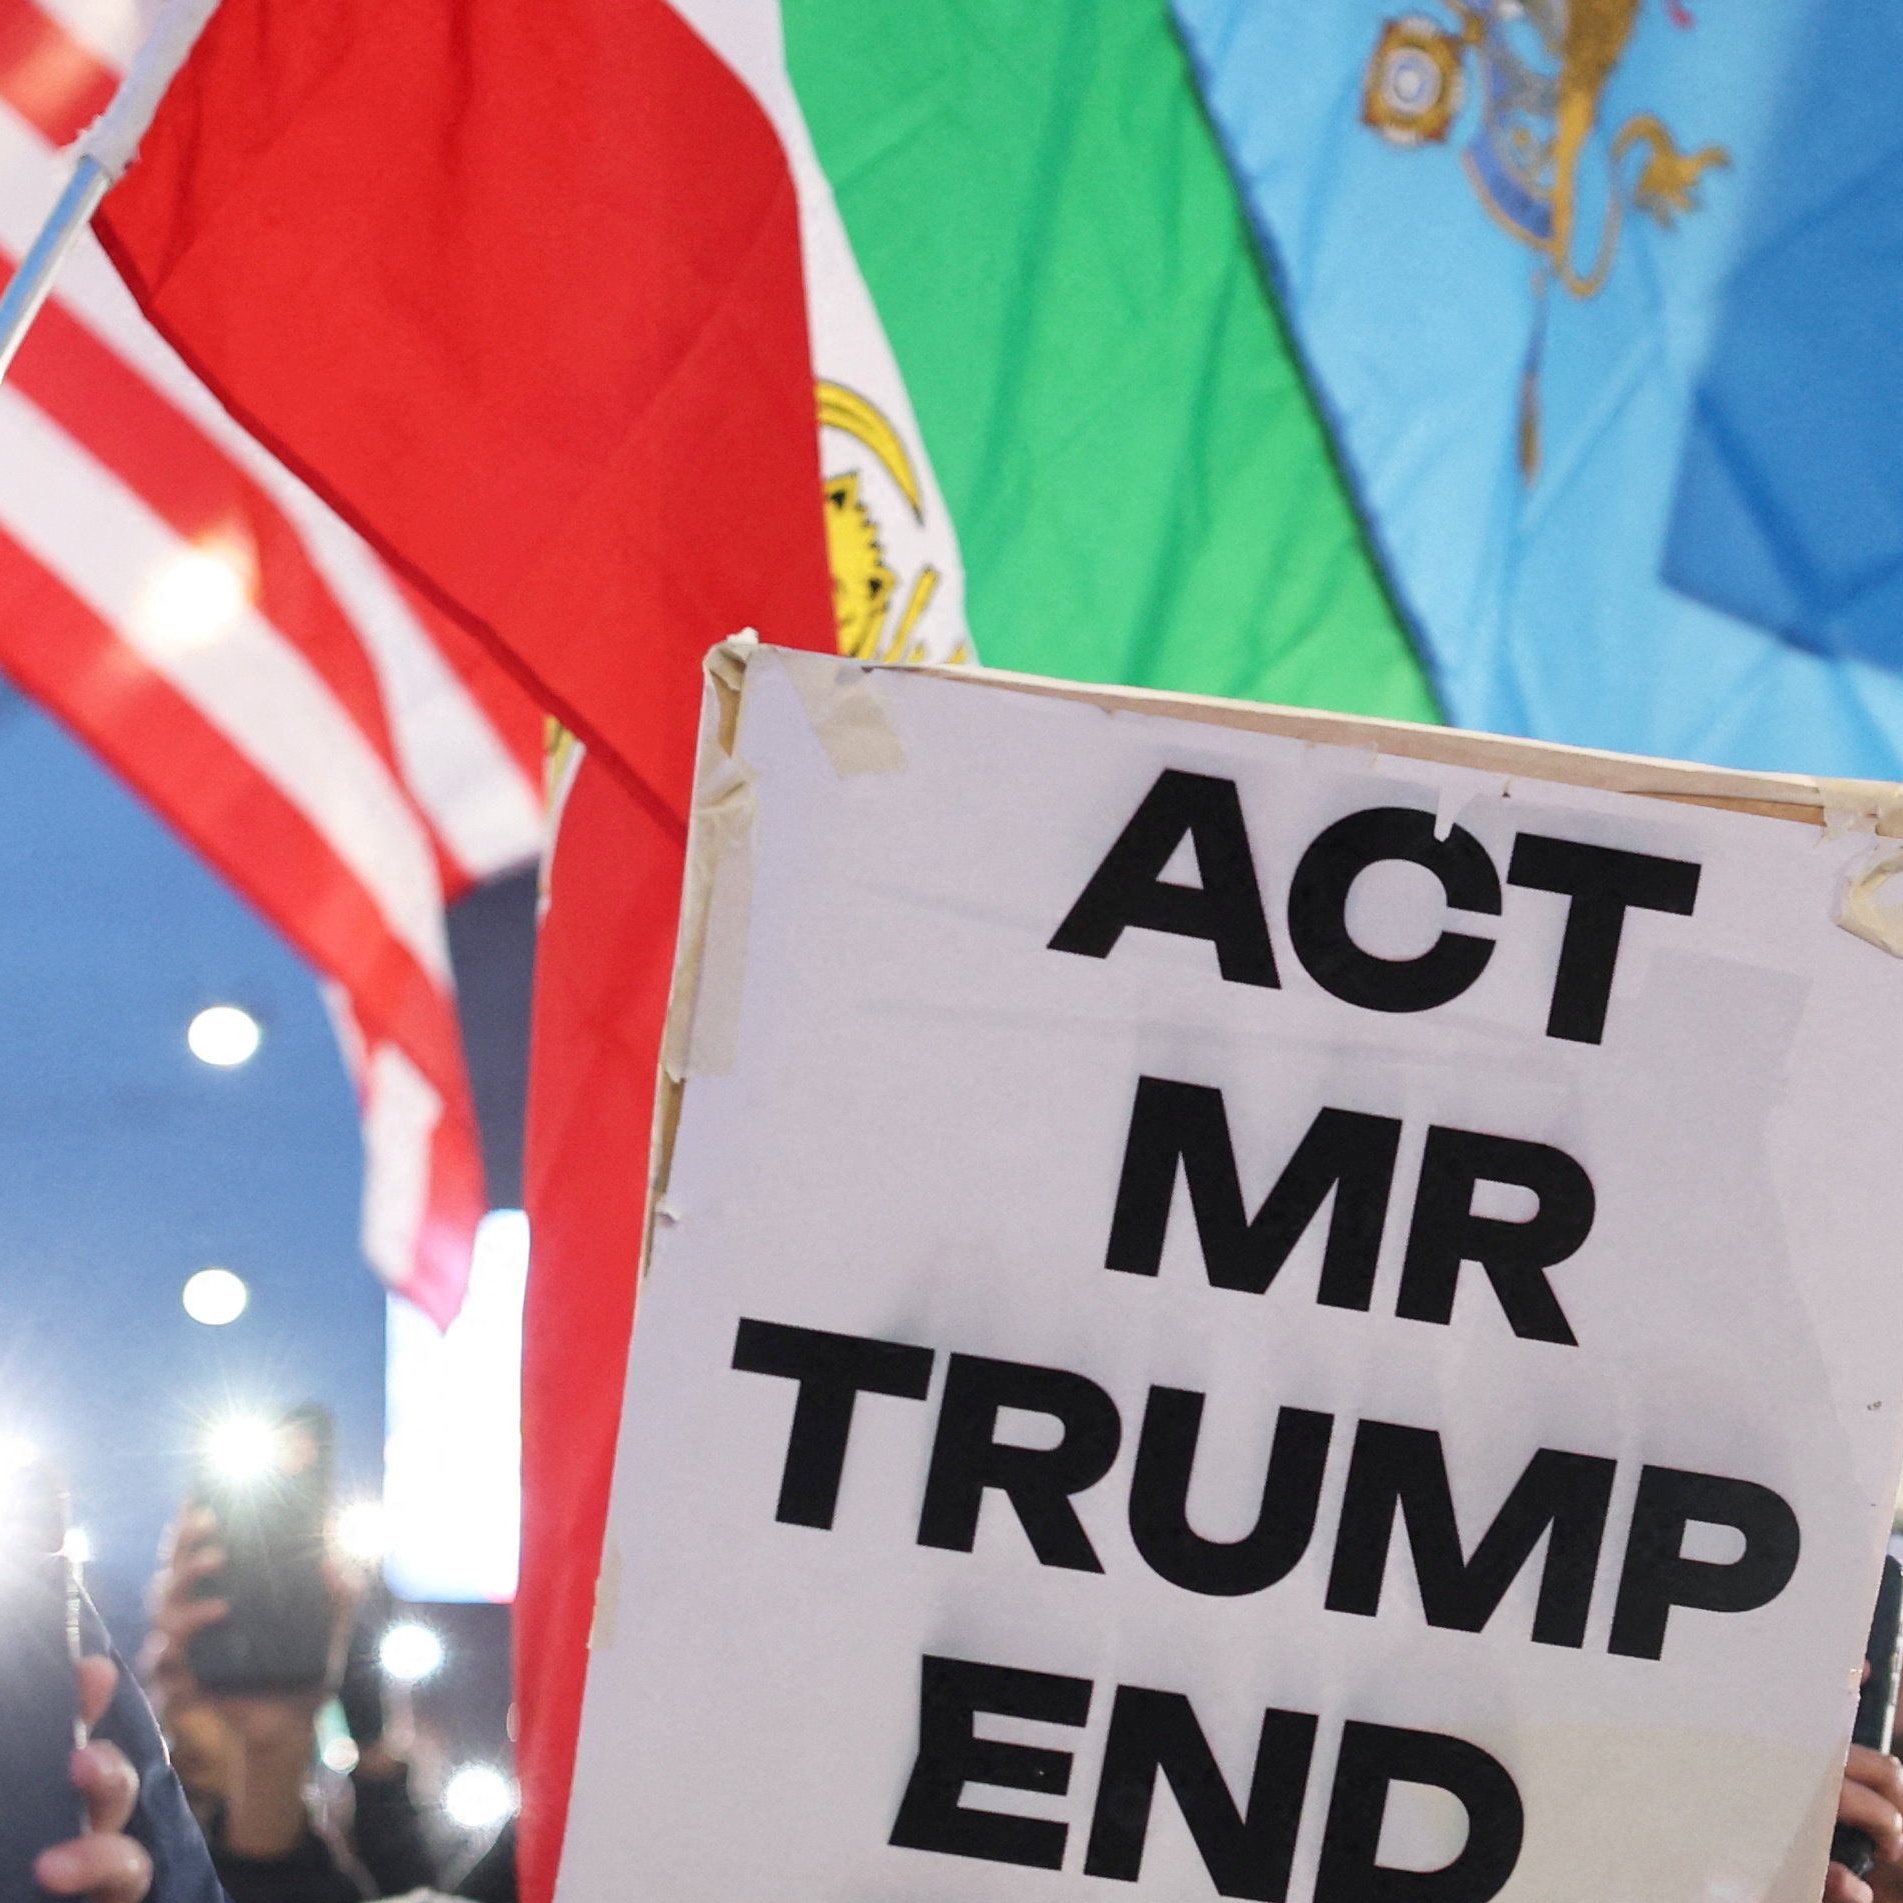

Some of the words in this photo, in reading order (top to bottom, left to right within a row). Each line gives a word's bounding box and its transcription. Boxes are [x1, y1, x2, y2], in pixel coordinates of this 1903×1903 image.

[1047, 769, 1701, 1046] ACT
[1105, 1076, 1595, 1346] MR
[732, 1318, 1799, 1660] TRUMP
